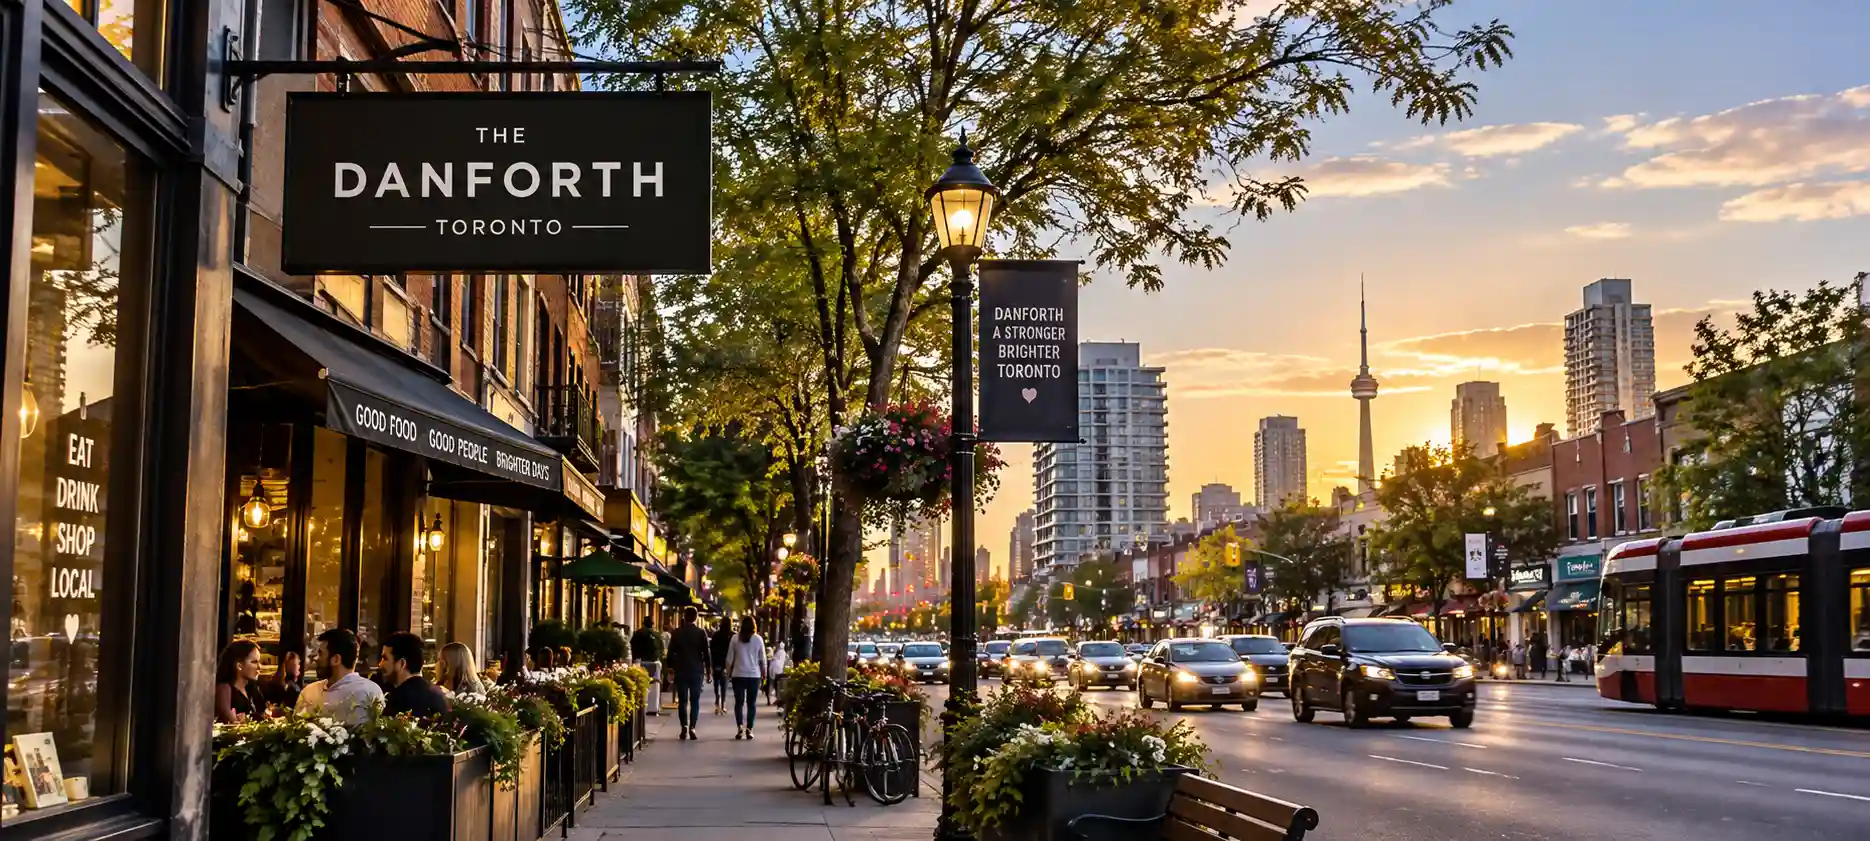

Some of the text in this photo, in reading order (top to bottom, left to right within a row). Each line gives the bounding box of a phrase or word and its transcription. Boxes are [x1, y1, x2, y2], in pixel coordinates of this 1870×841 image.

[476, 128, 524, 143] THE
[335, 162, 663, 197] DANFORTH
[436, 220, 561, 235] TORONTO
[995, 307, 1063, 321] DANFORTH
[993, 326, 1065, 340] A STRONGER
[999, 345, 1059, 359] BRIGHTER
[997, 364, 1060, 378] TORONTO
[69, 434, 93, 468] EAT
[356, 404, 549, 480] GOOD FOOD GOOD PEOPLE BRIGHTER DAYS
[57, 477, 99, 513] DRINK
[57, 523, 95, 555] SHOP
[52, 568, 94, 598] LOCAL
